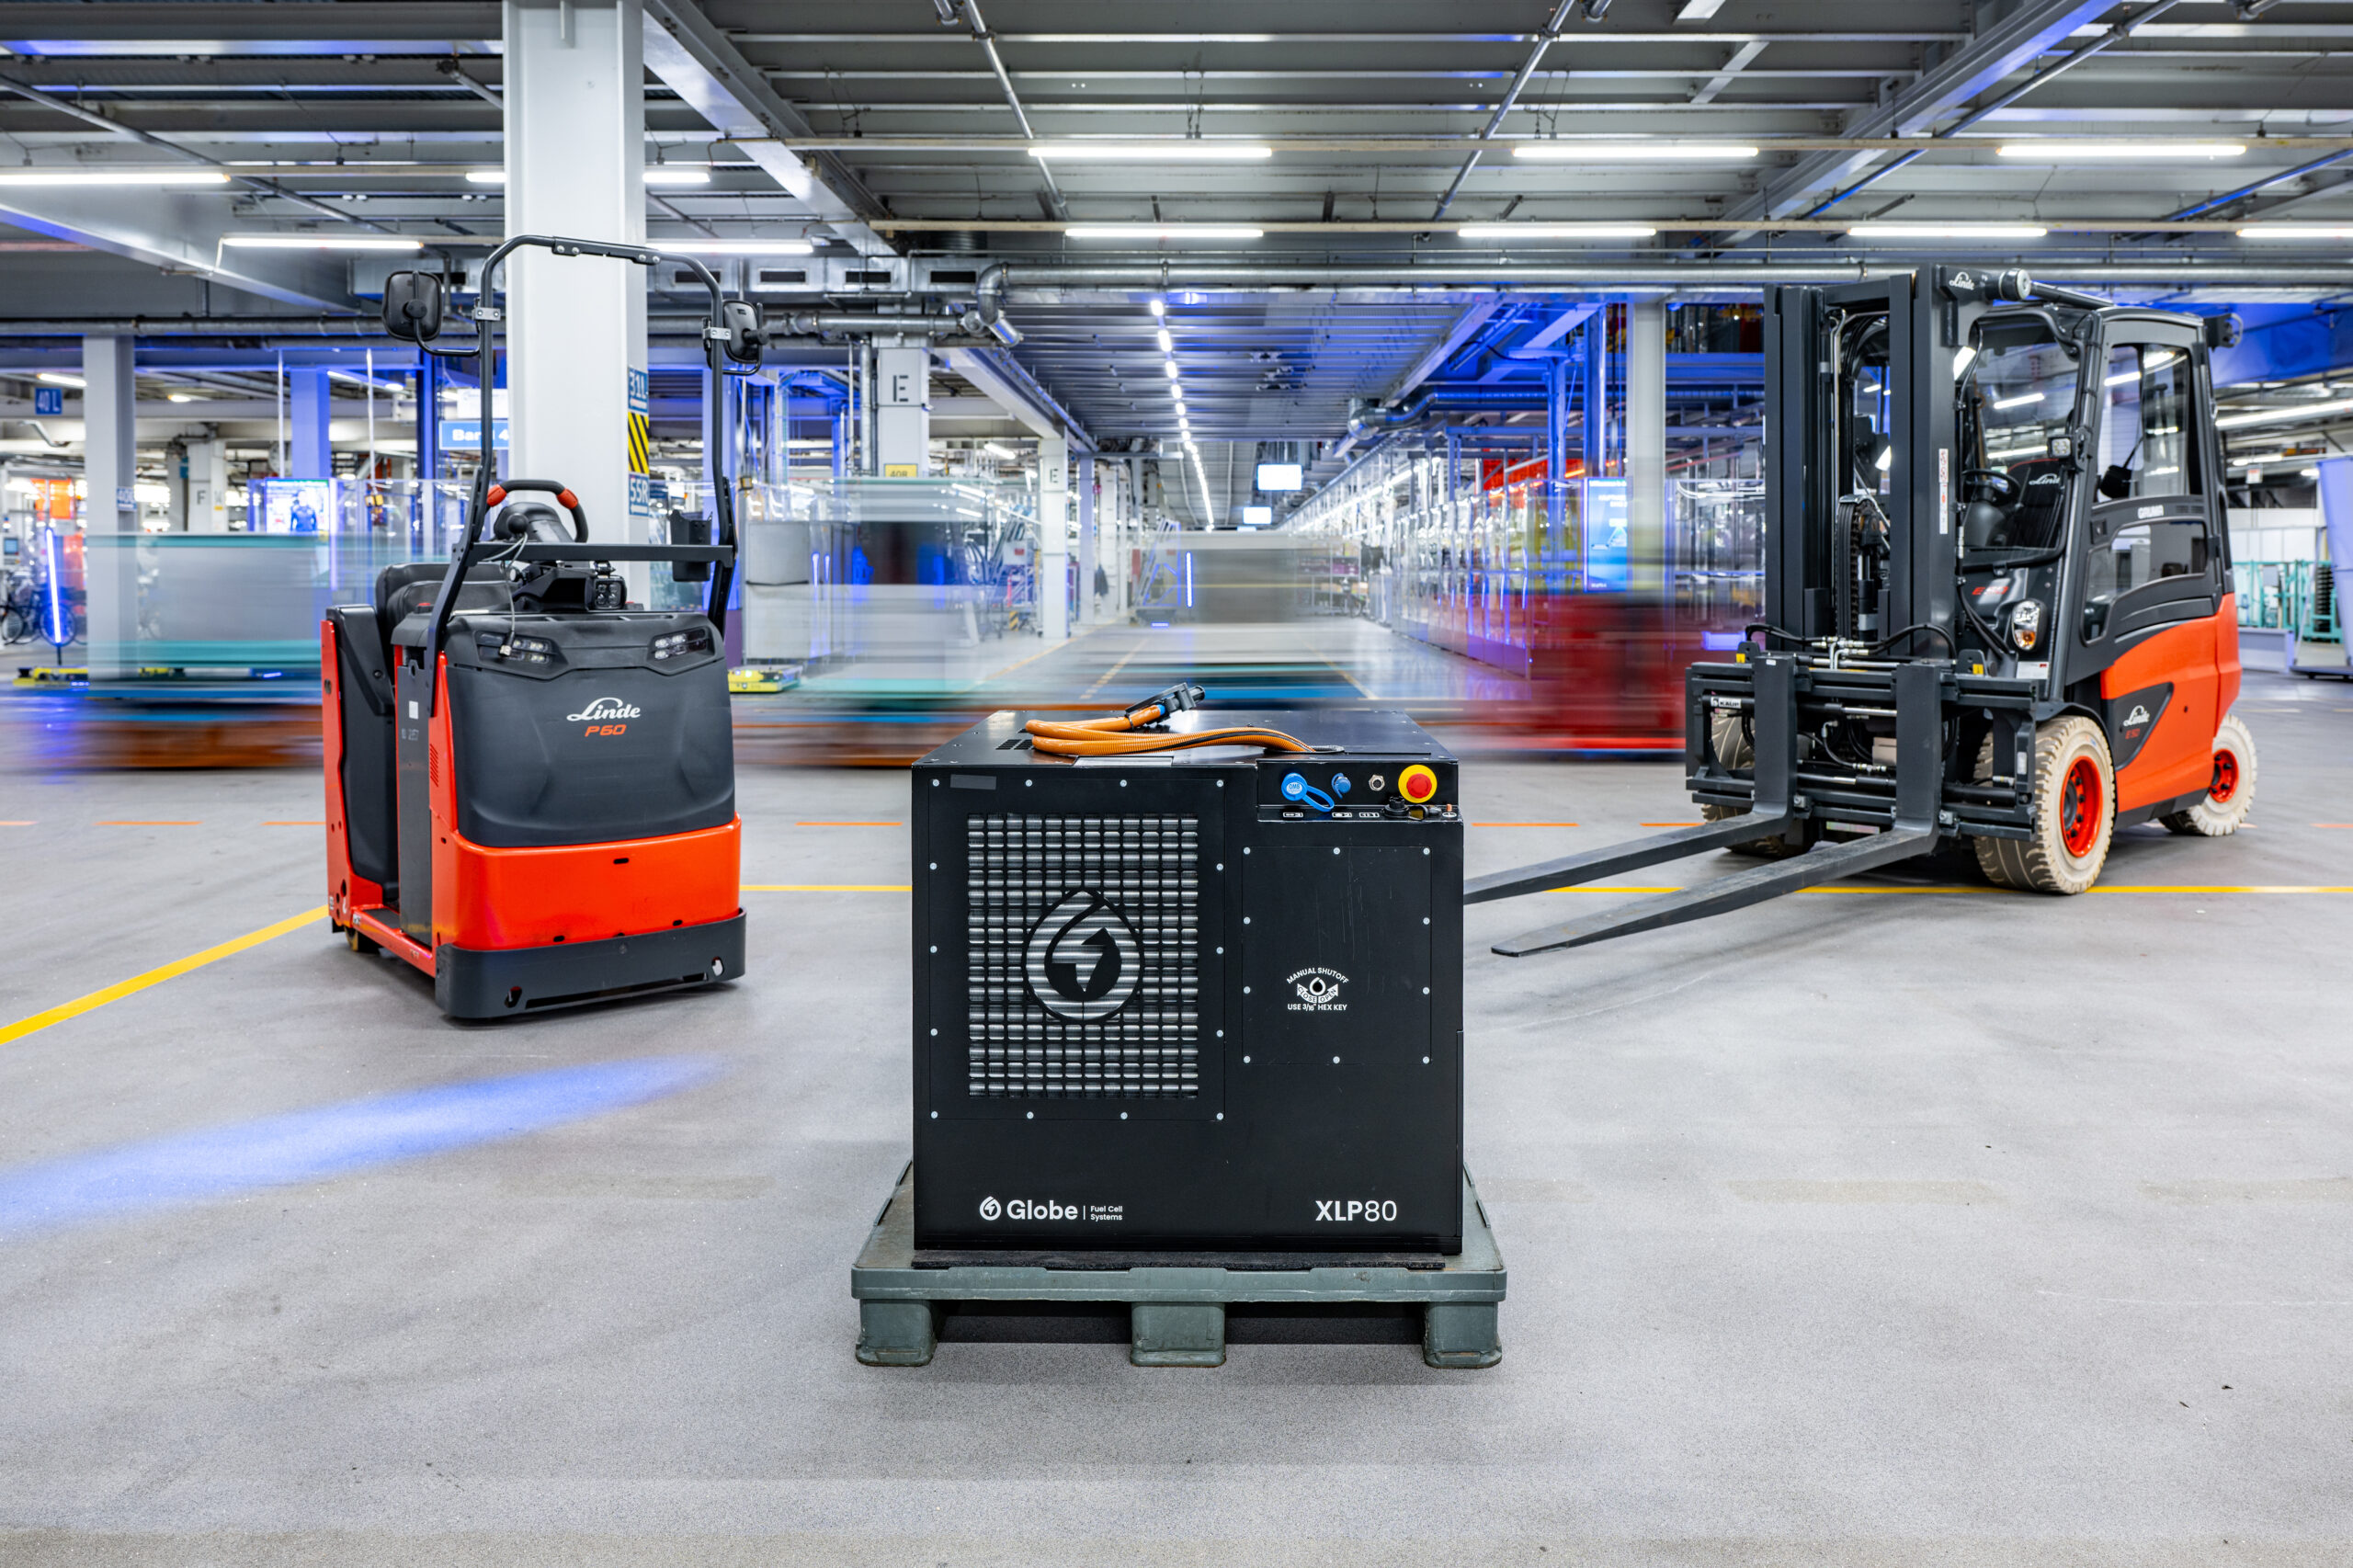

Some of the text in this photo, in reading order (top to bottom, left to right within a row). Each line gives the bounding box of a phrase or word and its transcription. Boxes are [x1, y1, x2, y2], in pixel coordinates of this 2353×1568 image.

[1949, 271, 1974, 290] Linde
[892, 375, 908, 402] E
[197, 490, 206, 505] F
[566, 697, 641, 722] Linde
[2123, 705, 2150, 726] Linde
[585, 724, 627, 737] P60
[1287, 967, 1349, 984] MANUAL SHUTOFF
[1298, 986, 1336, 1003] CLOSE OPEN
[1006, 1199, 1078, 1221] Globe
[1090, 1205, 1123, 1213] Fuel Cell
[1090, 1213, 1123, 1222] Systems
[1315, 1199, 1397, 1222] XLP80
